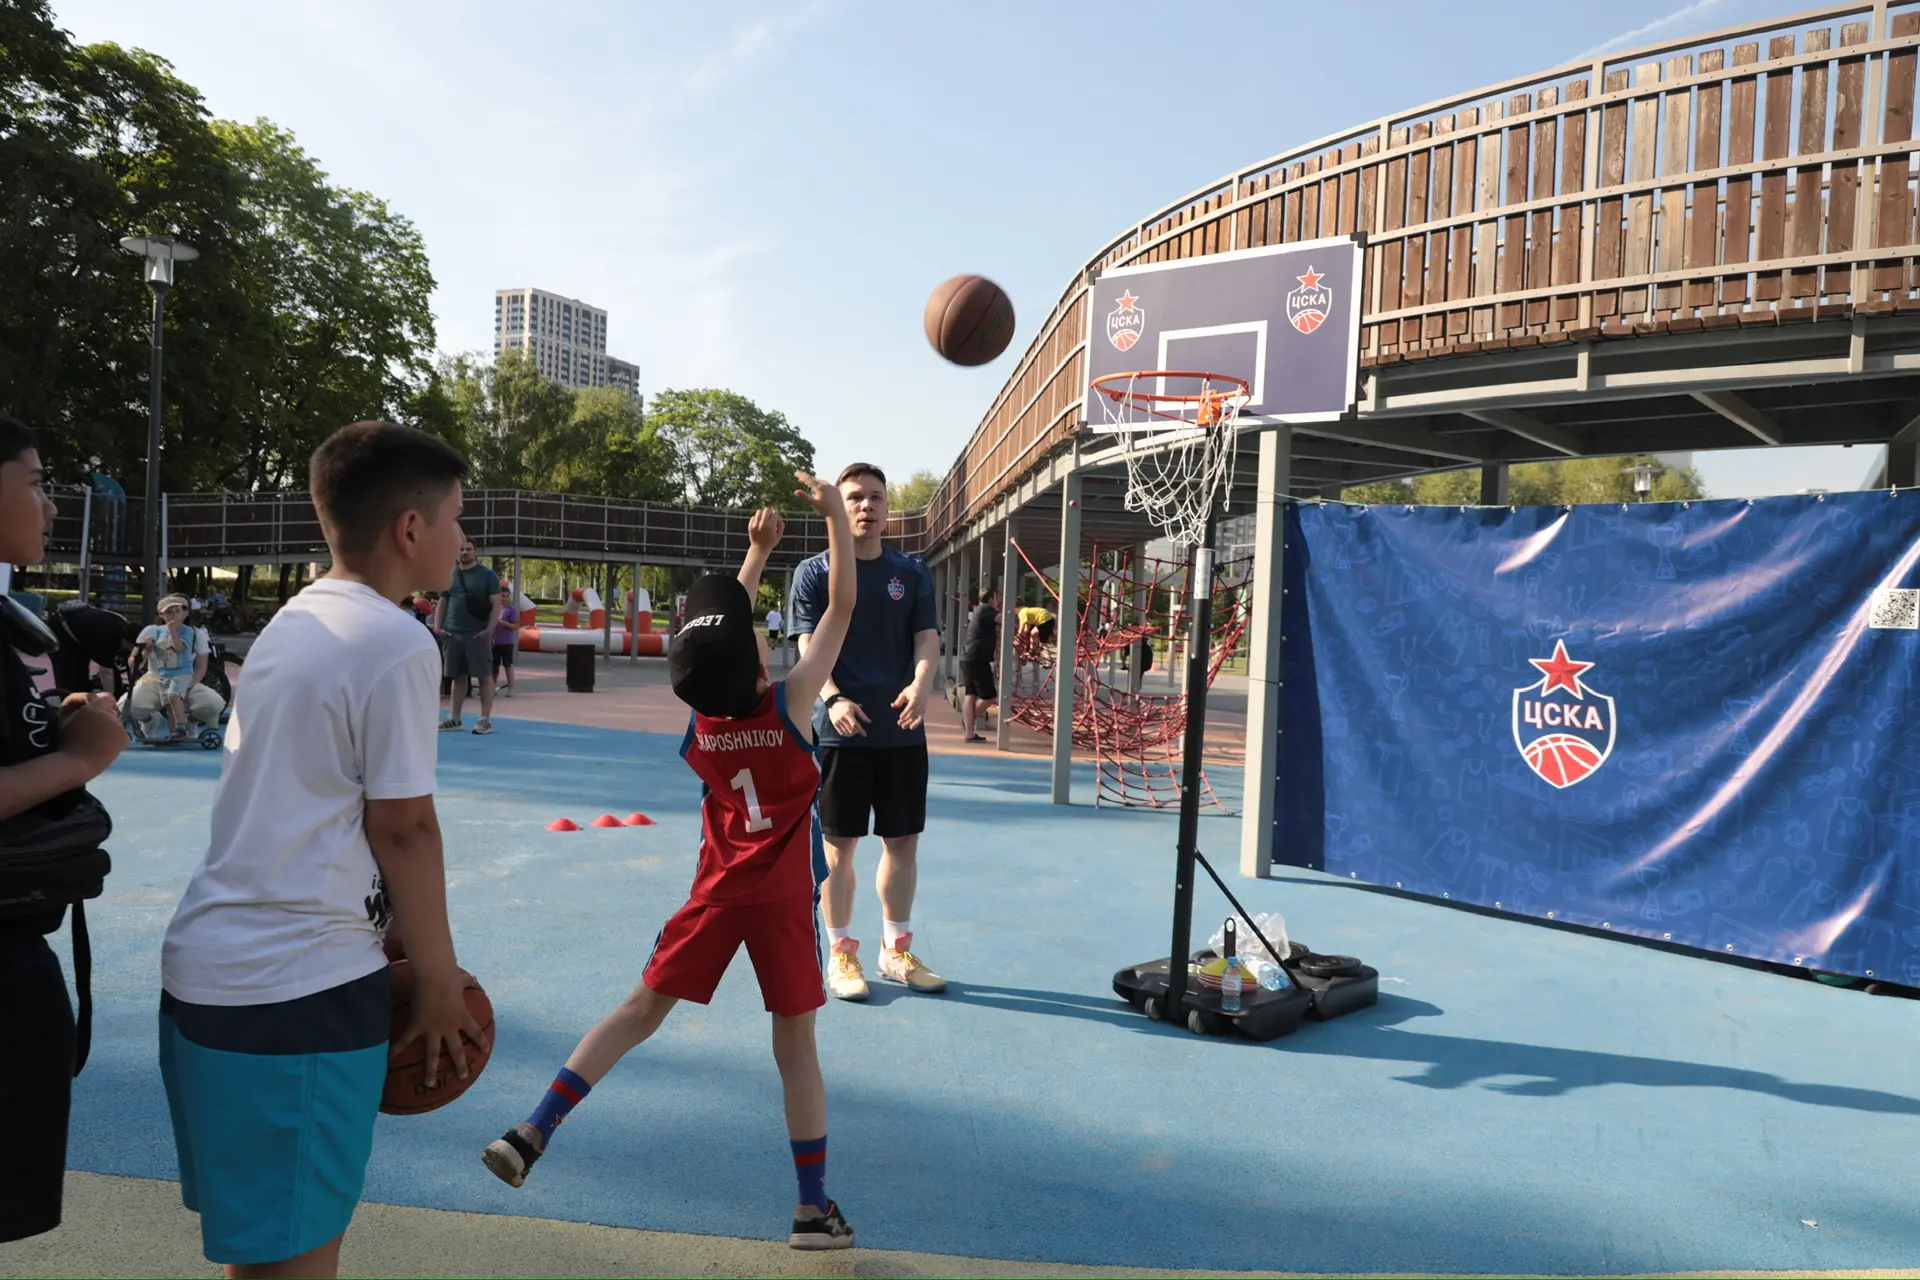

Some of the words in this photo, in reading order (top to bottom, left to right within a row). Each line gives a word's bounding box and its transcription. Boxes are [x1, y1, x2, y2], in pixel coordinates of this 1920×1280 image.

[1291, 293, 1327, 309] ЦСКА
[1111, 314, 1140, 330] ЦСКА
[1524, 700, 1605, 730] ЦСКА
[730, 768, 773, 834] 1
